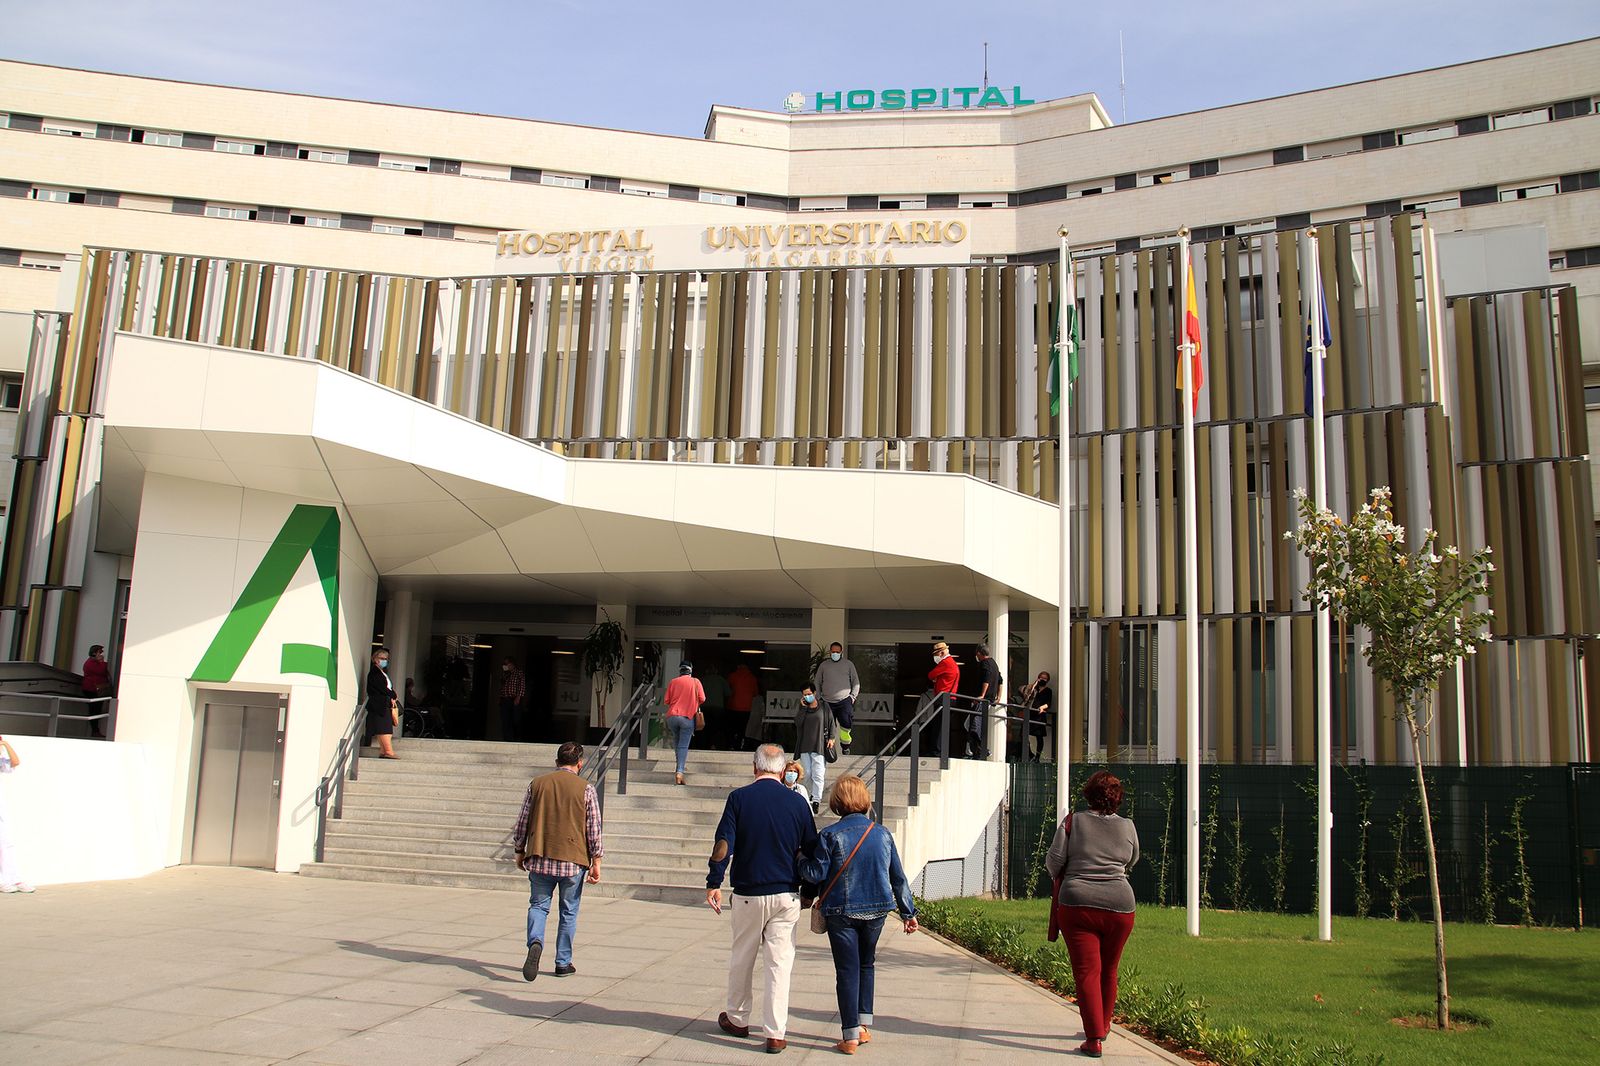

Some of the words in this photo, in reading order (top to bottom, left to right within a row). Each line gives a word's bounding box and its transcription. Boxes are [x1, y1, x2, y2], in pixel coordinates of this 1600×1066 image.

[815, 86, 1035, 112] HOSPITAL
[497, 229, 653, 256] HOSPITAL
[706, 220, 967, 249] UNIVERSITARIO
[558, 255, 654, 272] VIRGEN
[746, 249, 896, 268] MACARENA
